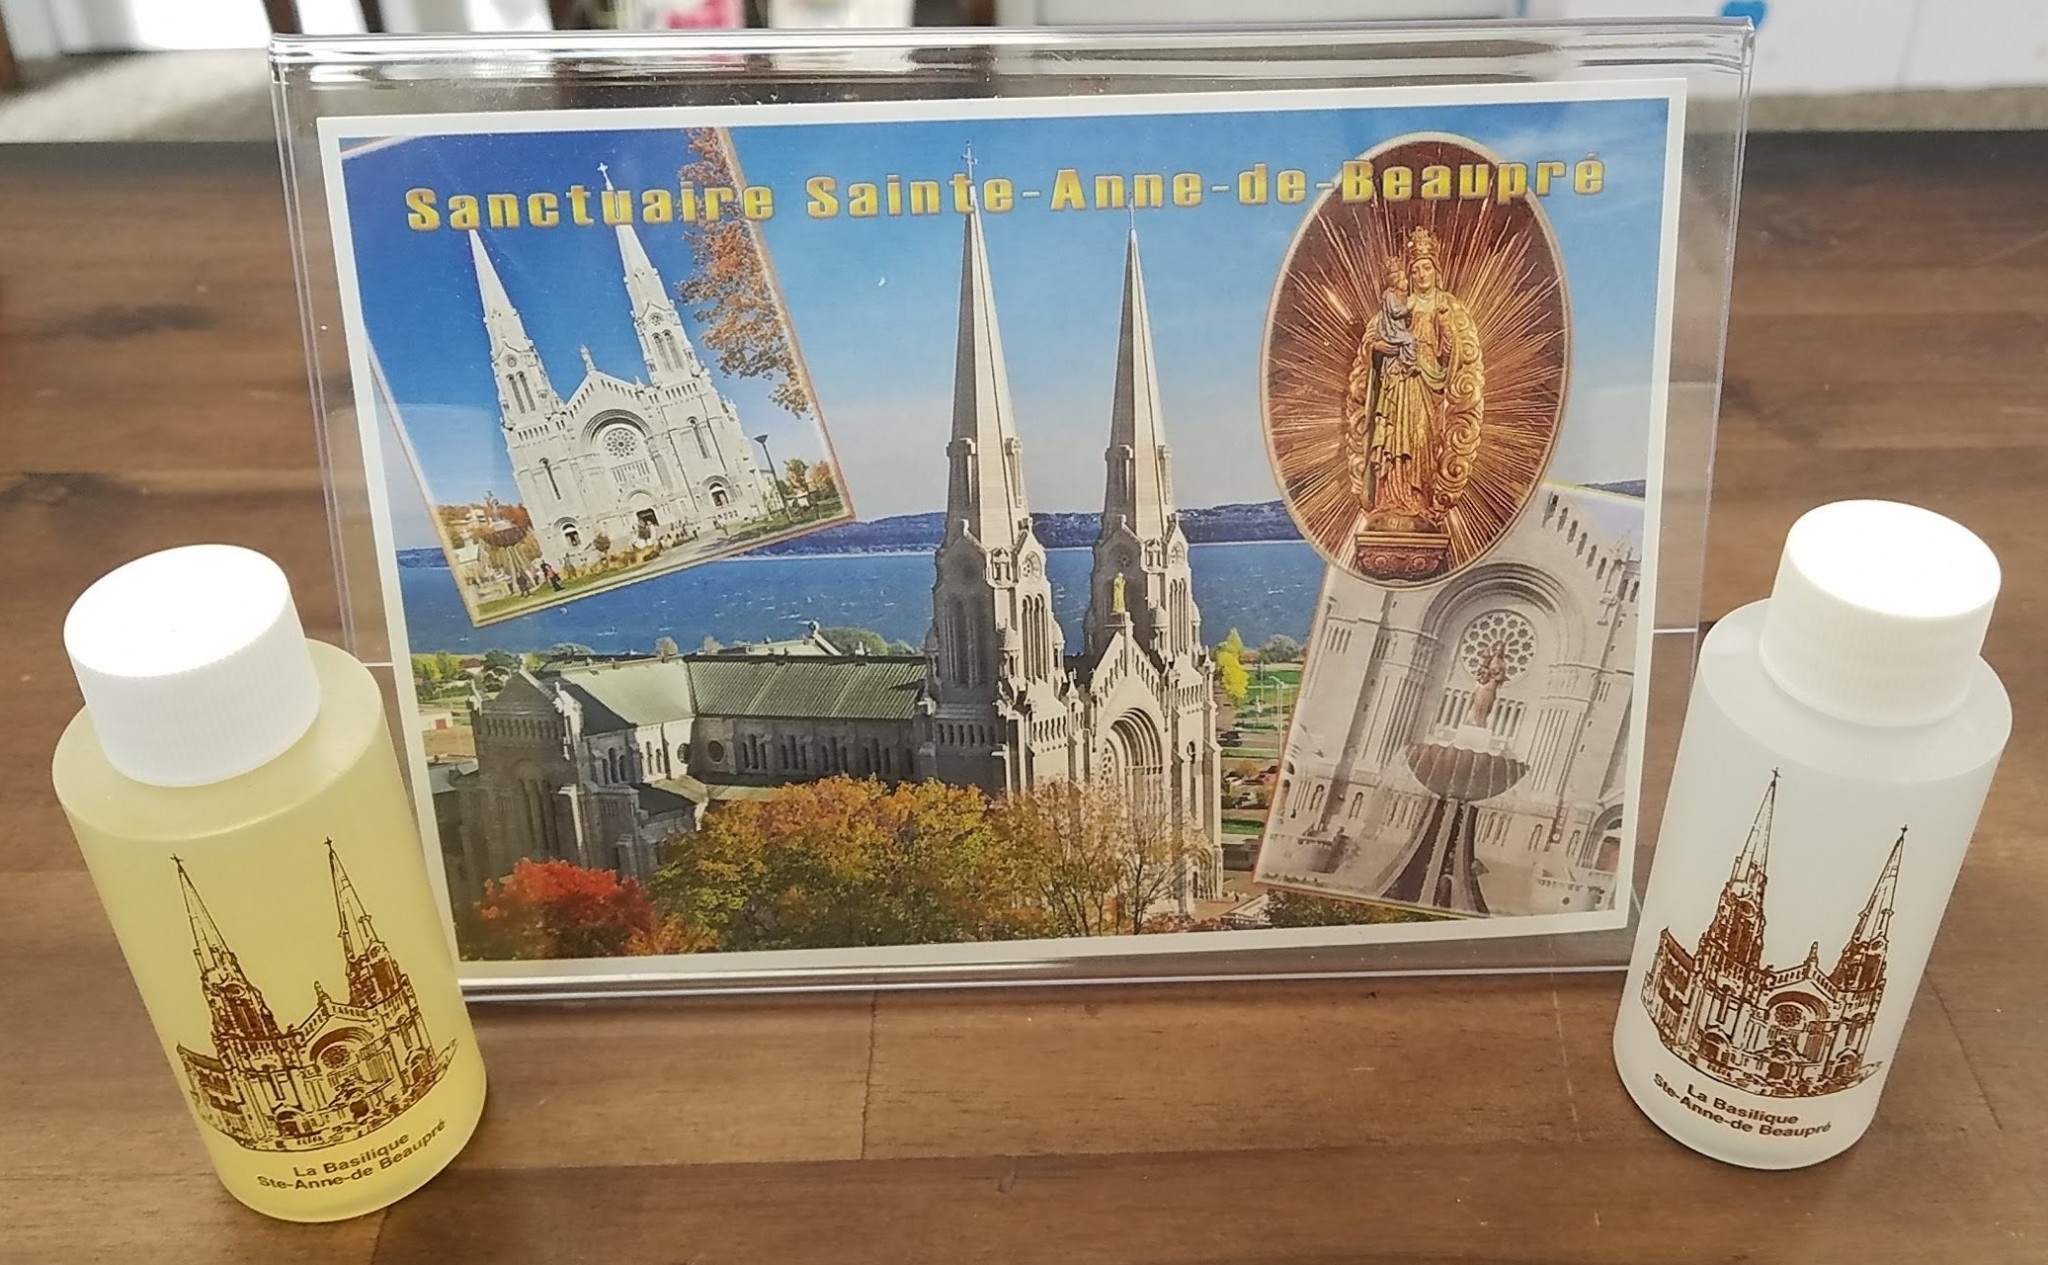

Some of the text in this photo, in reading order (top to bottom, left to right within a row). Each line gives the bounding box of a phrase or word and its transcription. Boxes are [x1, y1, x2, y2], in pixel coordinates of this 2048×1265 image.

[405, 153, 1606, 231] Sanctuaire Sainte-Anne-de-Beaupré
[1653, 1073, 1831, 1138] Ste-Anne-de Beaupré
[1686, 1083, 1799, 1125] La Basilique
[257, 1118, 446, 1190] Ste-Anne-de Beaupré
[292, 1133, 409, 1178] La Basilique
